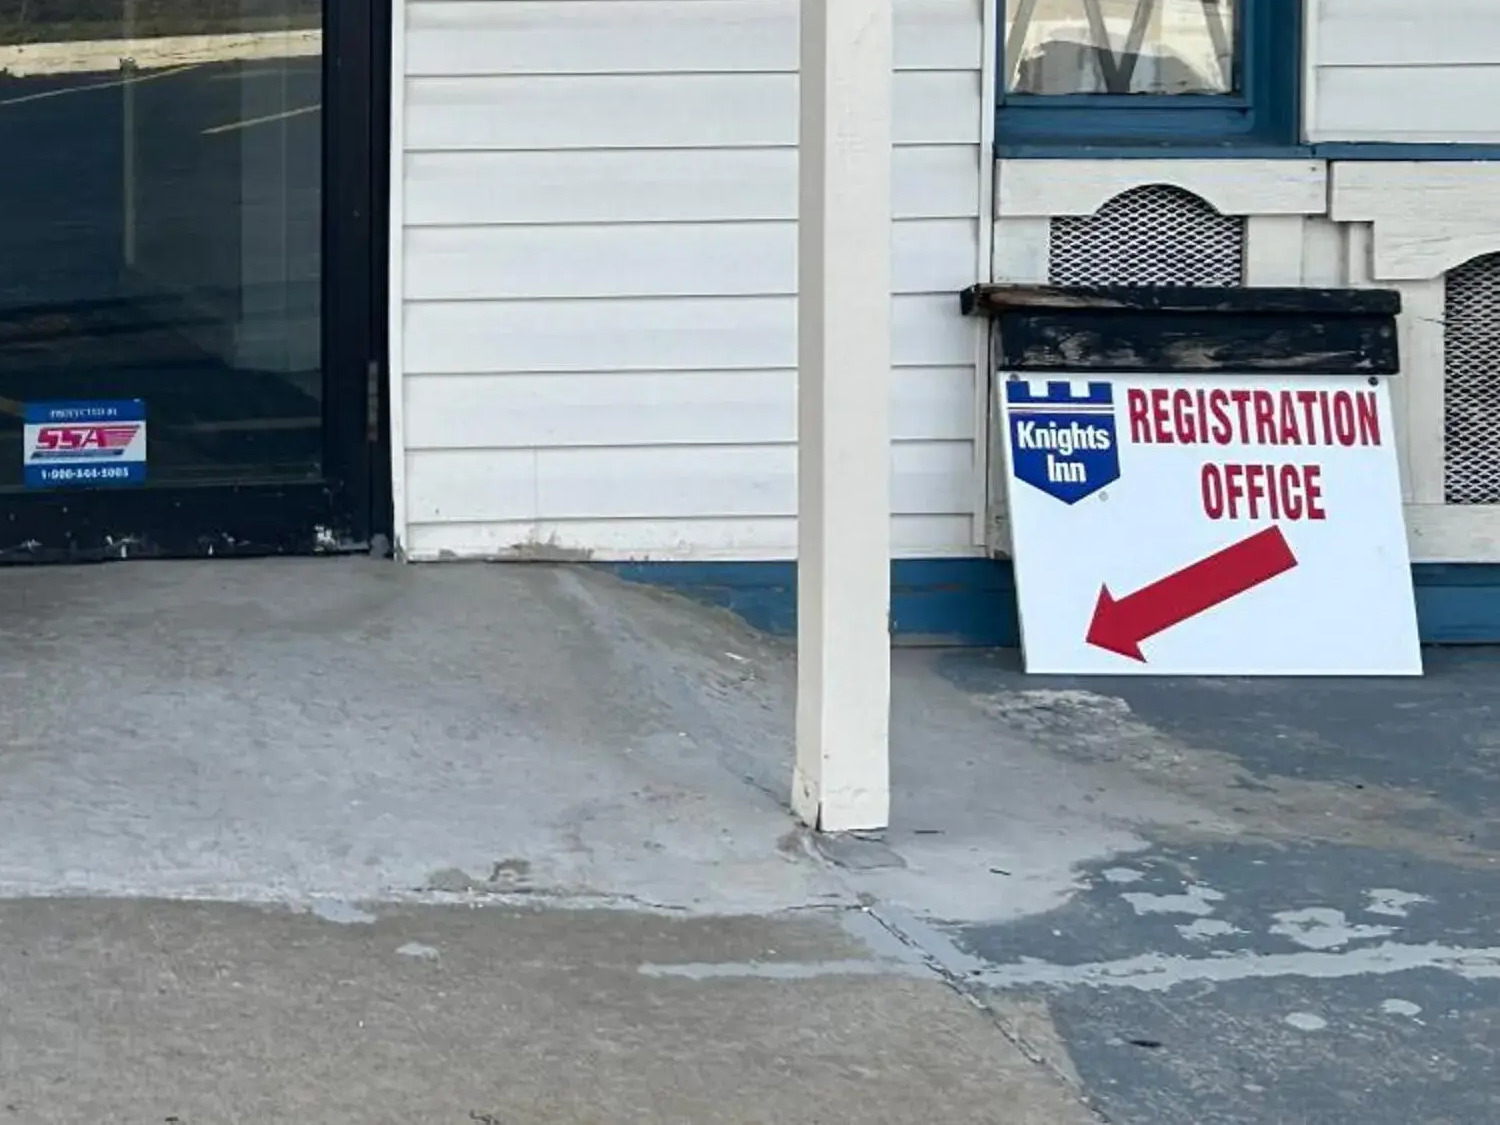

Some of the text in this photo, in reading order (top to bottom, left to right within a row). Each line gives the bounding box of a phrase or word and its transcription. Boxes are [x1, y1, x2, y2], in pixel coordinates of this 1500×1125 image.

[1127, 388, 1382, 447] REGISTRATION
[37, 427, 106, 450] SSA
[1017, 421, 1111, 456] Knights
[1048, 453, 1086, 482] Inn
[1201, 462, 1326, 520] OFFICE
